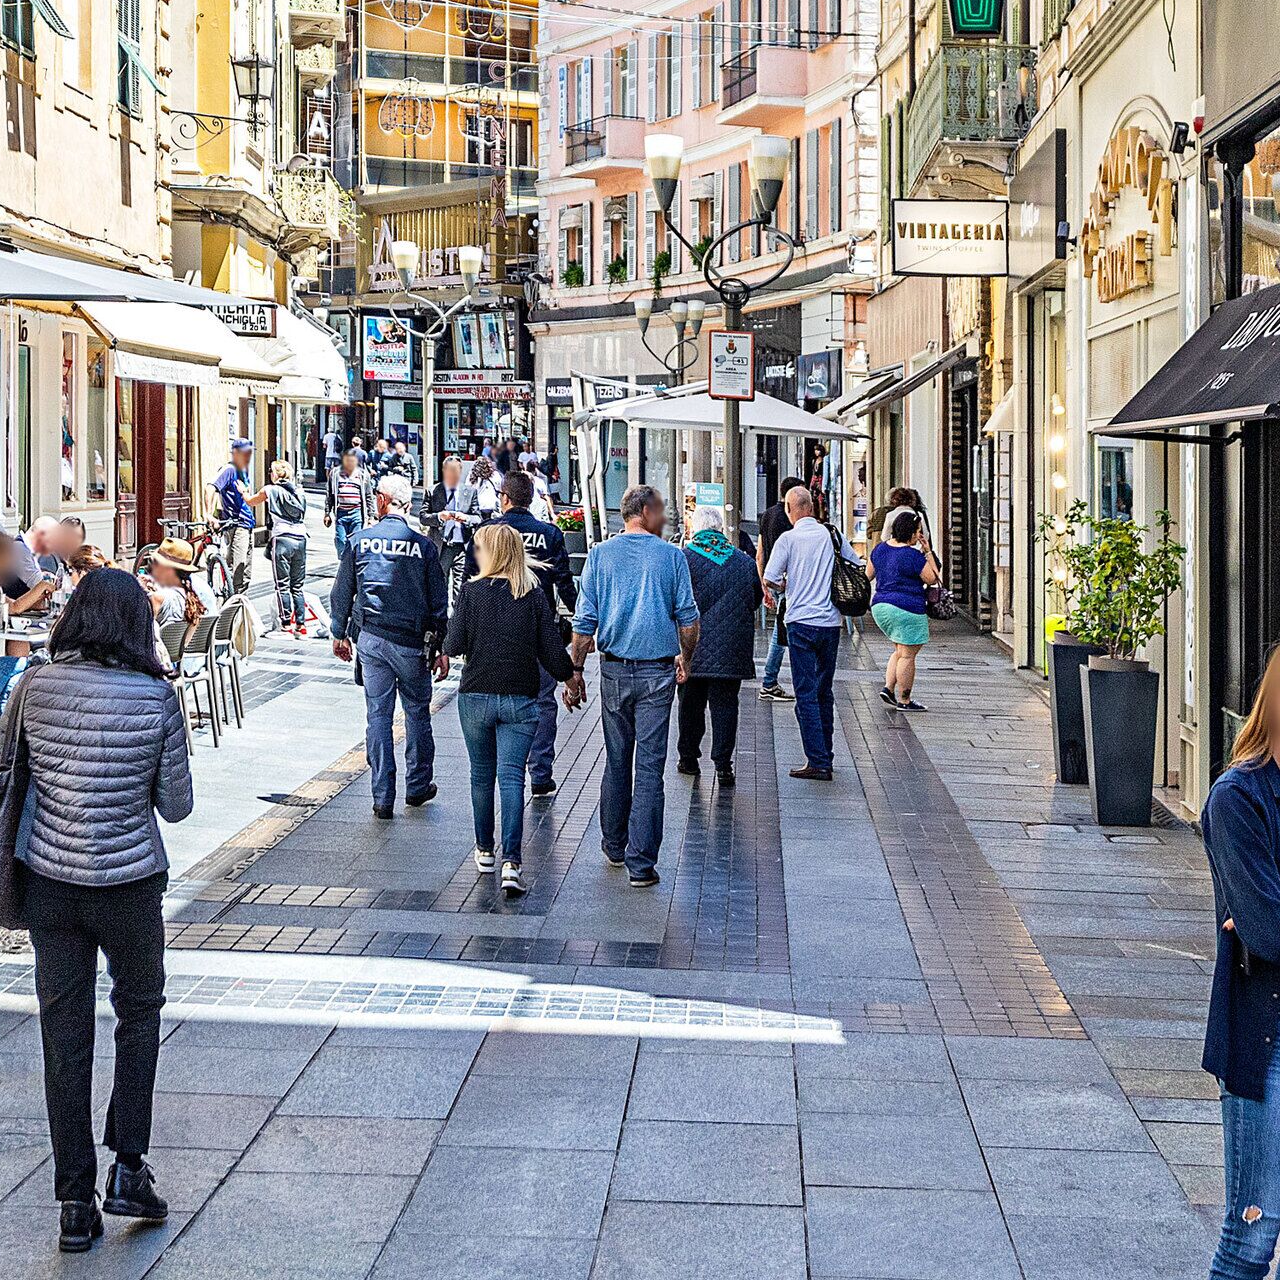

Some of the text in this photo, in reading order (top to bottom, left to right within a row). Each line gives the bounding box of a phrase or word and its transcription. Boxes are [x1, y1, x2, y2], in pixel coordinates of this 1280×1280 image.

[896, 221, 1005, 241] VINTAGERIA
[215, 314, 267, 325] NCHIGLIA
[359, 538, 423, 559] POLIZIA
[521, 532, 548, 550] ZIA
